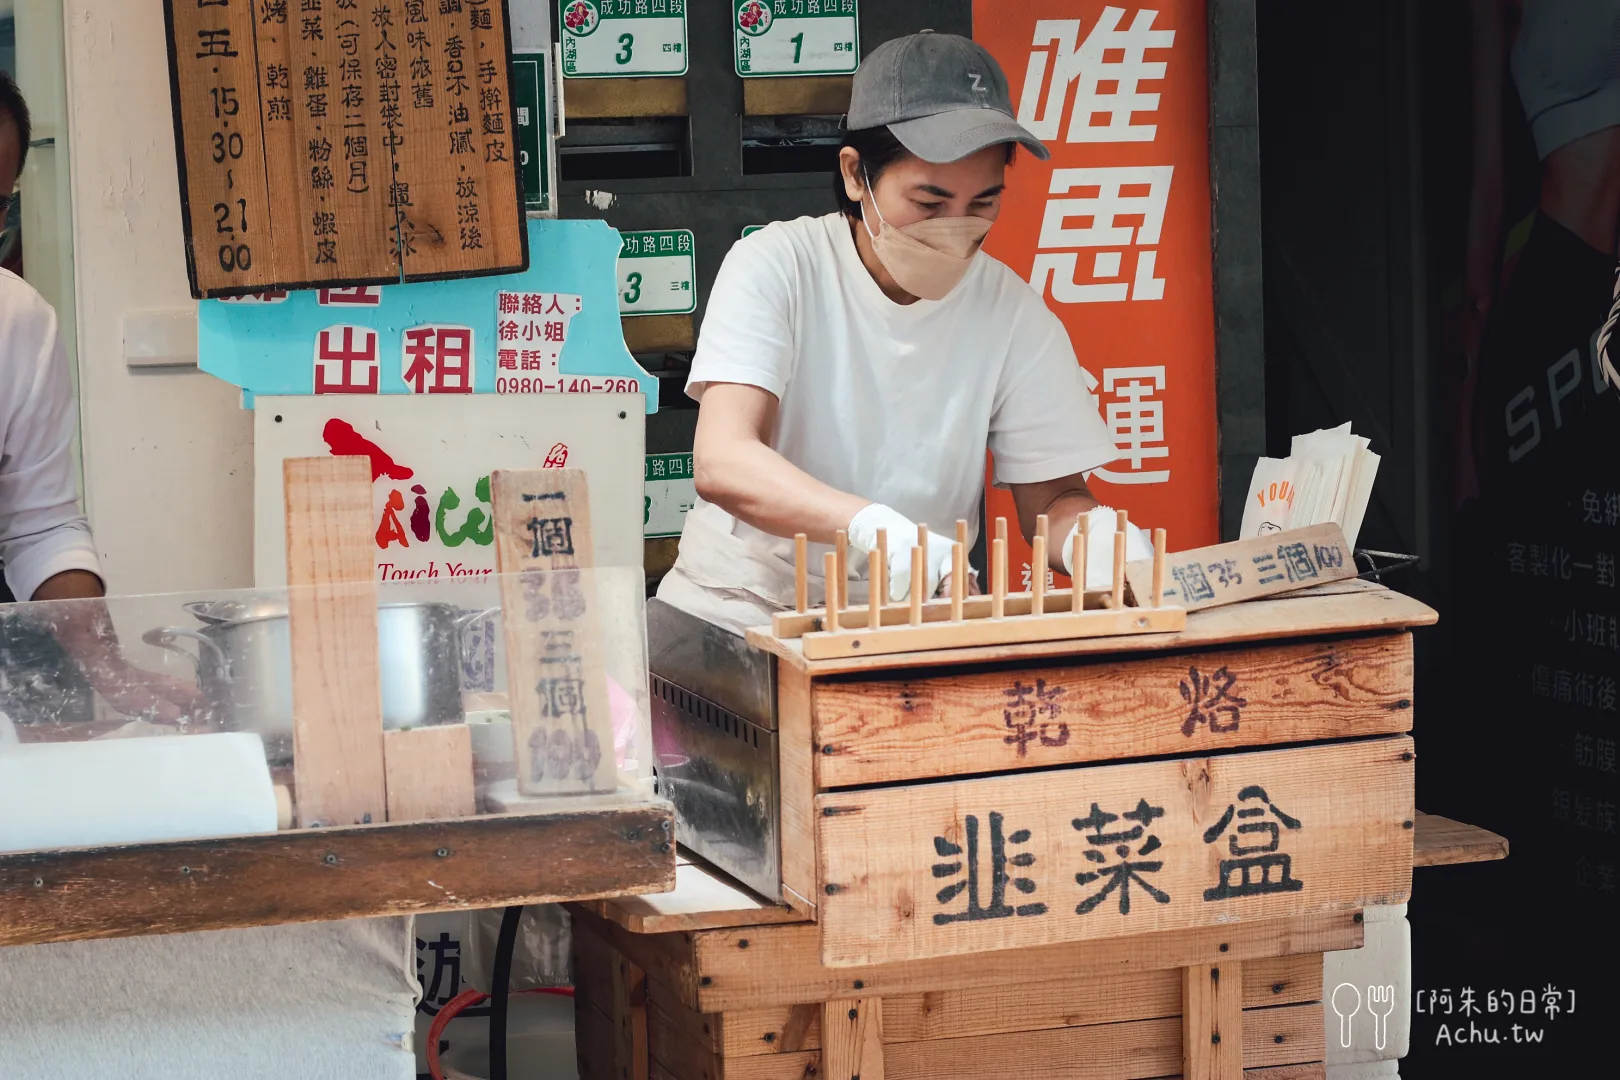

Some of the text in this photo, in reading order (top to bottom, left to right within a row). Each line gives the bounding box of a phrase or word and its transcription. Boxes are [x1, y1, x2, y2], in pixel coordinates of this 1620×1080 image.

[600, 0, 683, 15] 成功路四段
[773, 0, 854, 15] 成功路四段
[615, 33, 634, 65] 3
[662, 42, 682, 53] 四樓
[790, 32, 804, 64] 1
[833, 41, 853, 52] 四樓
[967, 73, 987, 91] Z
[1016, 6, 1176, 304] 唯思
[624, 271, 643, 304] 3
[670, 280, 690, 291] 三樓
[498, 321, 565, 342] 徐小姐
[314, 327, 473, 394] 出租
[496, 378, 639, 394] 0980-140-260
[377, 562, 493, 585] Touch Your
[931, 784, 1303, 926] 韭菜盒
